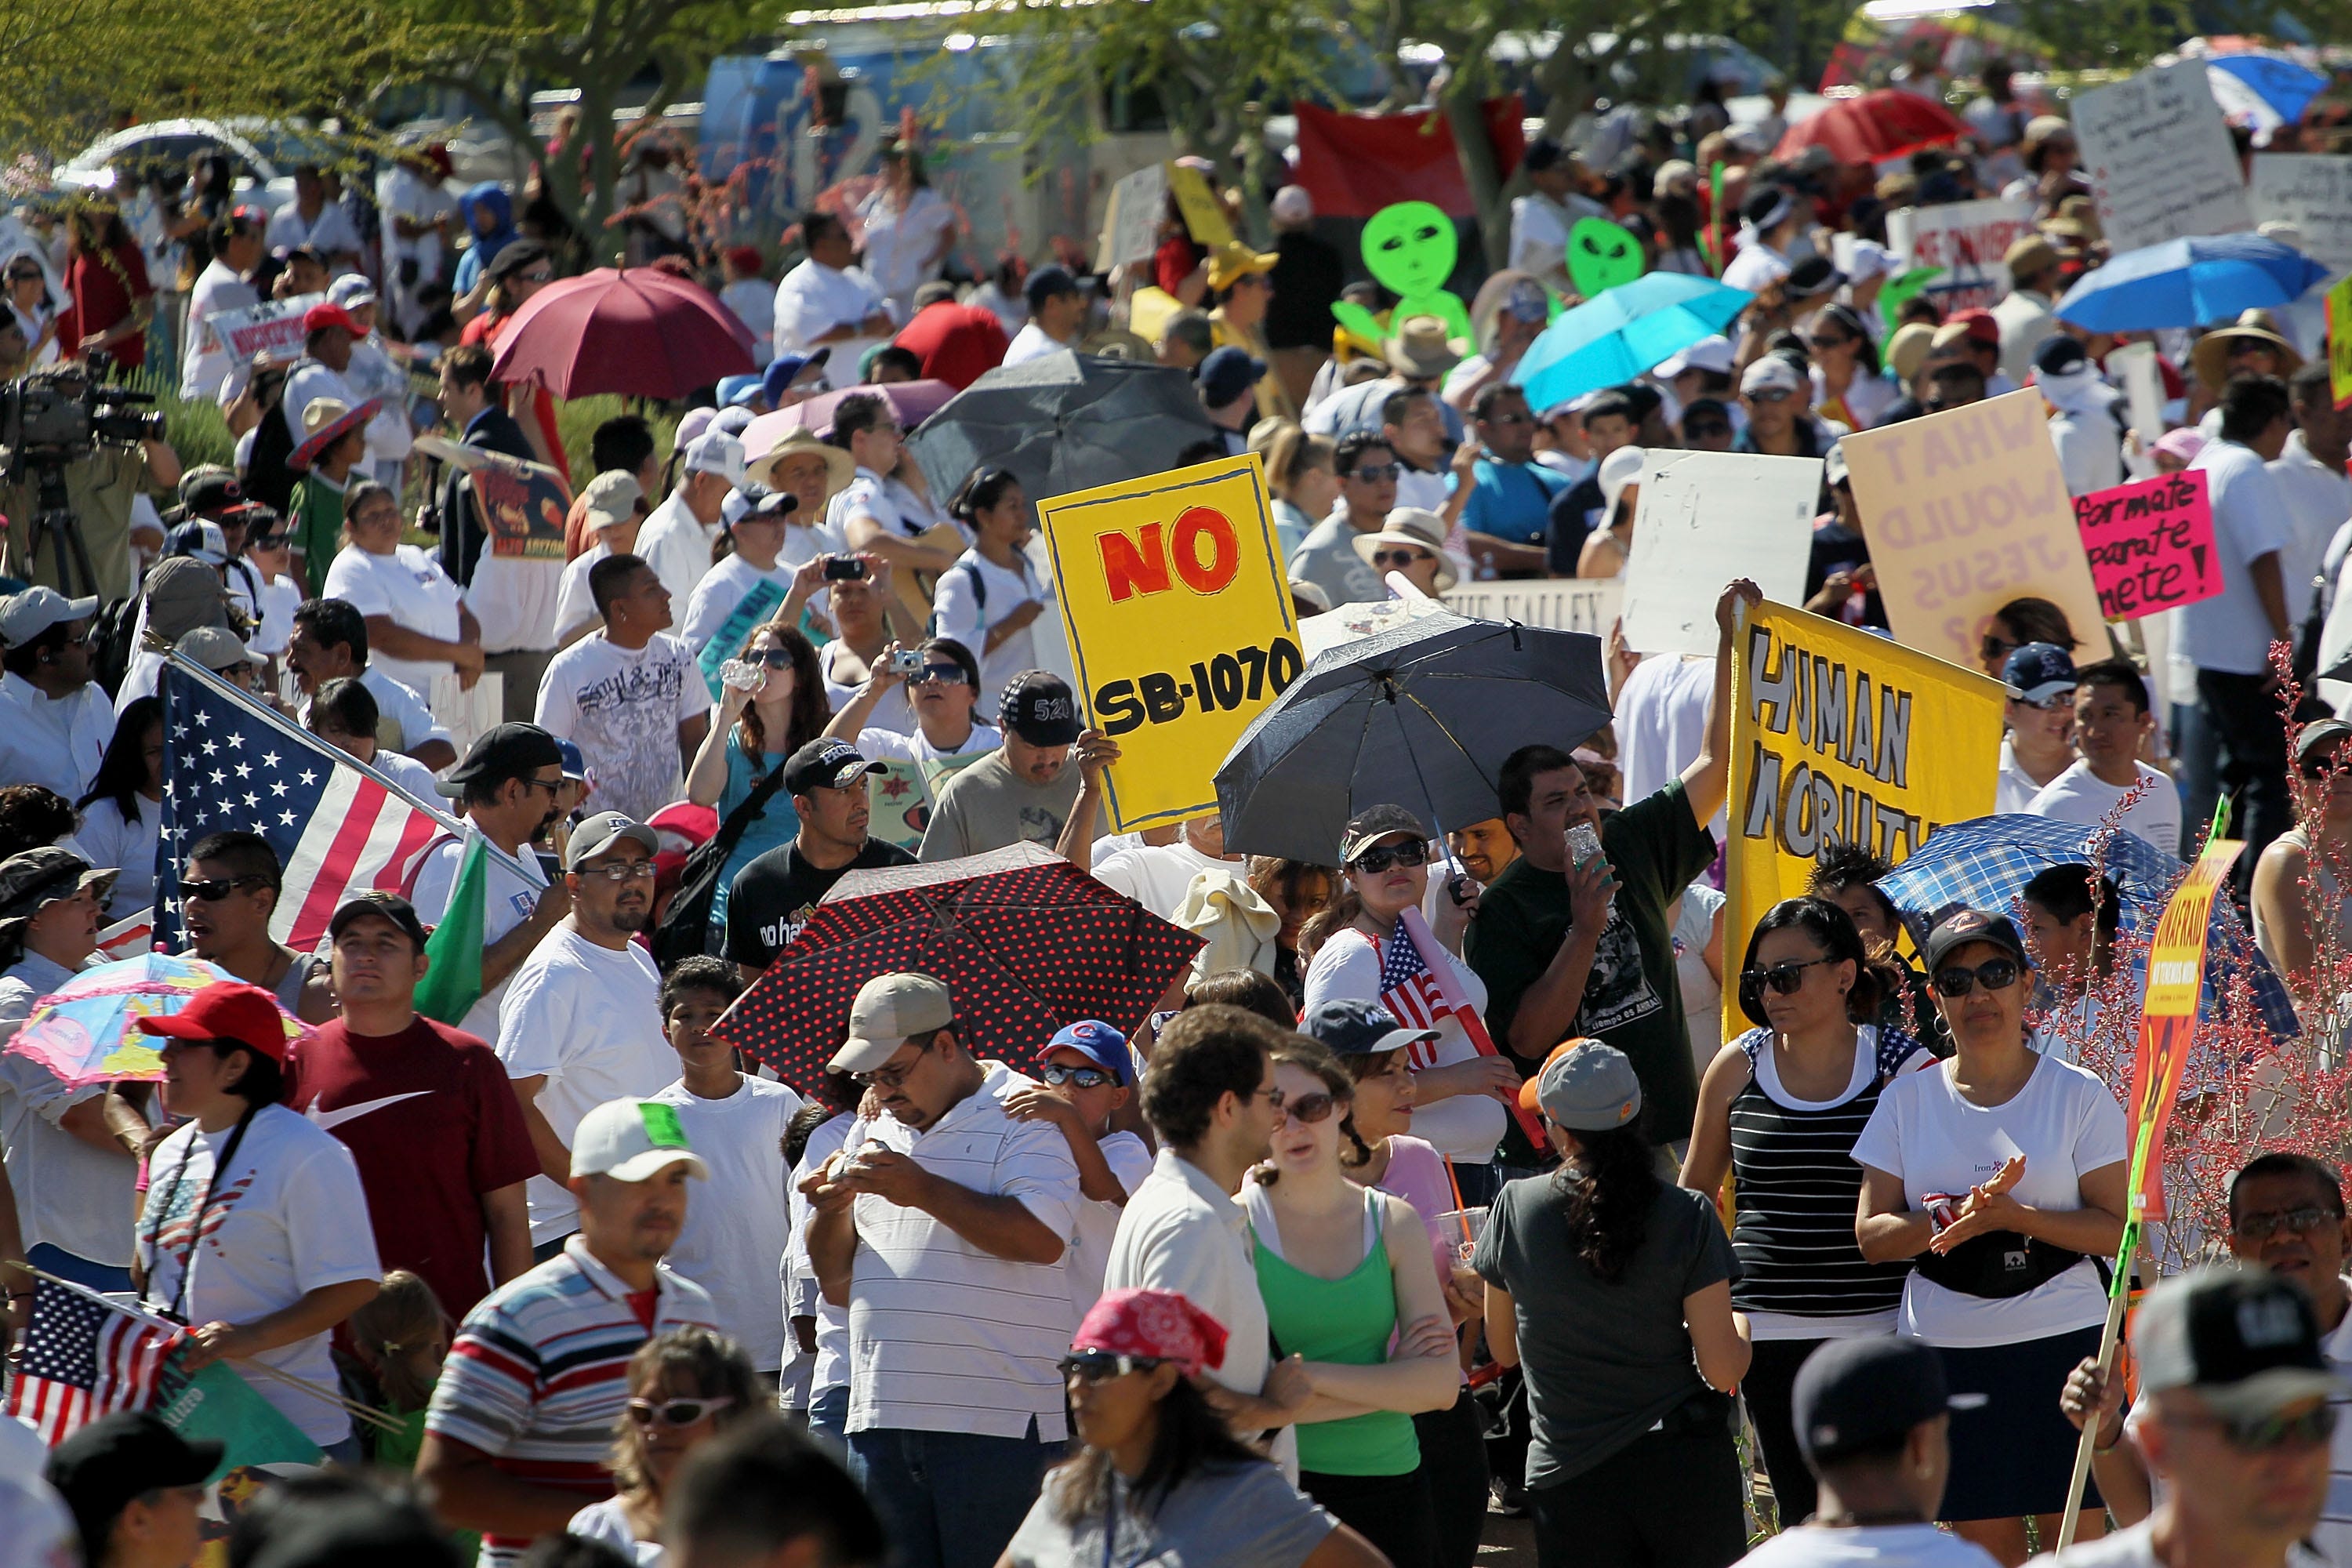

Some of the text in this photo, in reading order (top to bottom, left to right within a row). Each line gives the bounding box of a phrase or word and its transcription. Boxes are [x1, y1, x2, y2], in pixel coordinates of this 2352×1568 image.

[1094, 506, 1241, 604] NO
[736, 579, 779, 619] WAIT
[1504, 593, 1604, 637] VALLEY
[1094, 637, 1305, 737] SB-1070
[1749, 623, 1912, 789] HUMAN
[760, 925, 776, 947] no
[2158, 897, 2206, 948] UNAFRAID
[1624, 1008, 1635, 1018] es
[1974, 1163, 1991, 1173] Iron
